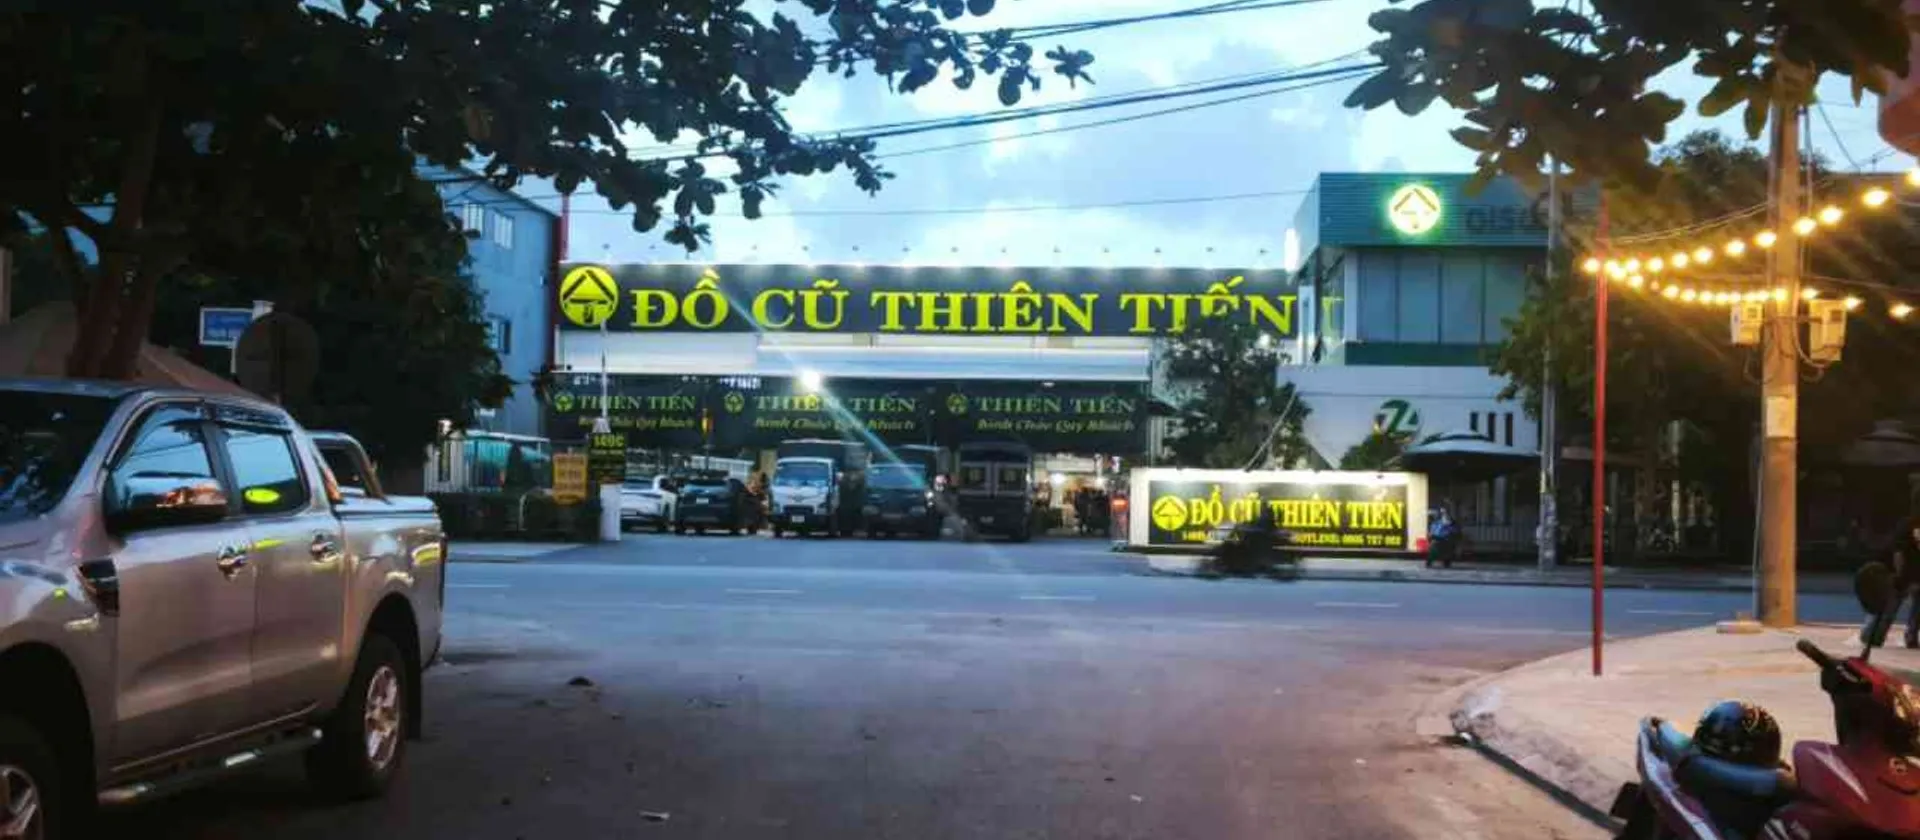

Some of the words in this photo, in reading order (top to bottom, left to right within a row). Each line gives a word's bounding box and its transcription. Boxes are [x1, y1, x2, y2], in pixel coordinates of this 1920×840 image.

[630, 269, 729, 329] ĐỒ
[752, 278, 850, 330] CŨ
[870, 280, 1099, 333] THIÊN
[1119, 275, 1297, 335] TIẾN
[1267, 493, 1341, 528] THIÊN
